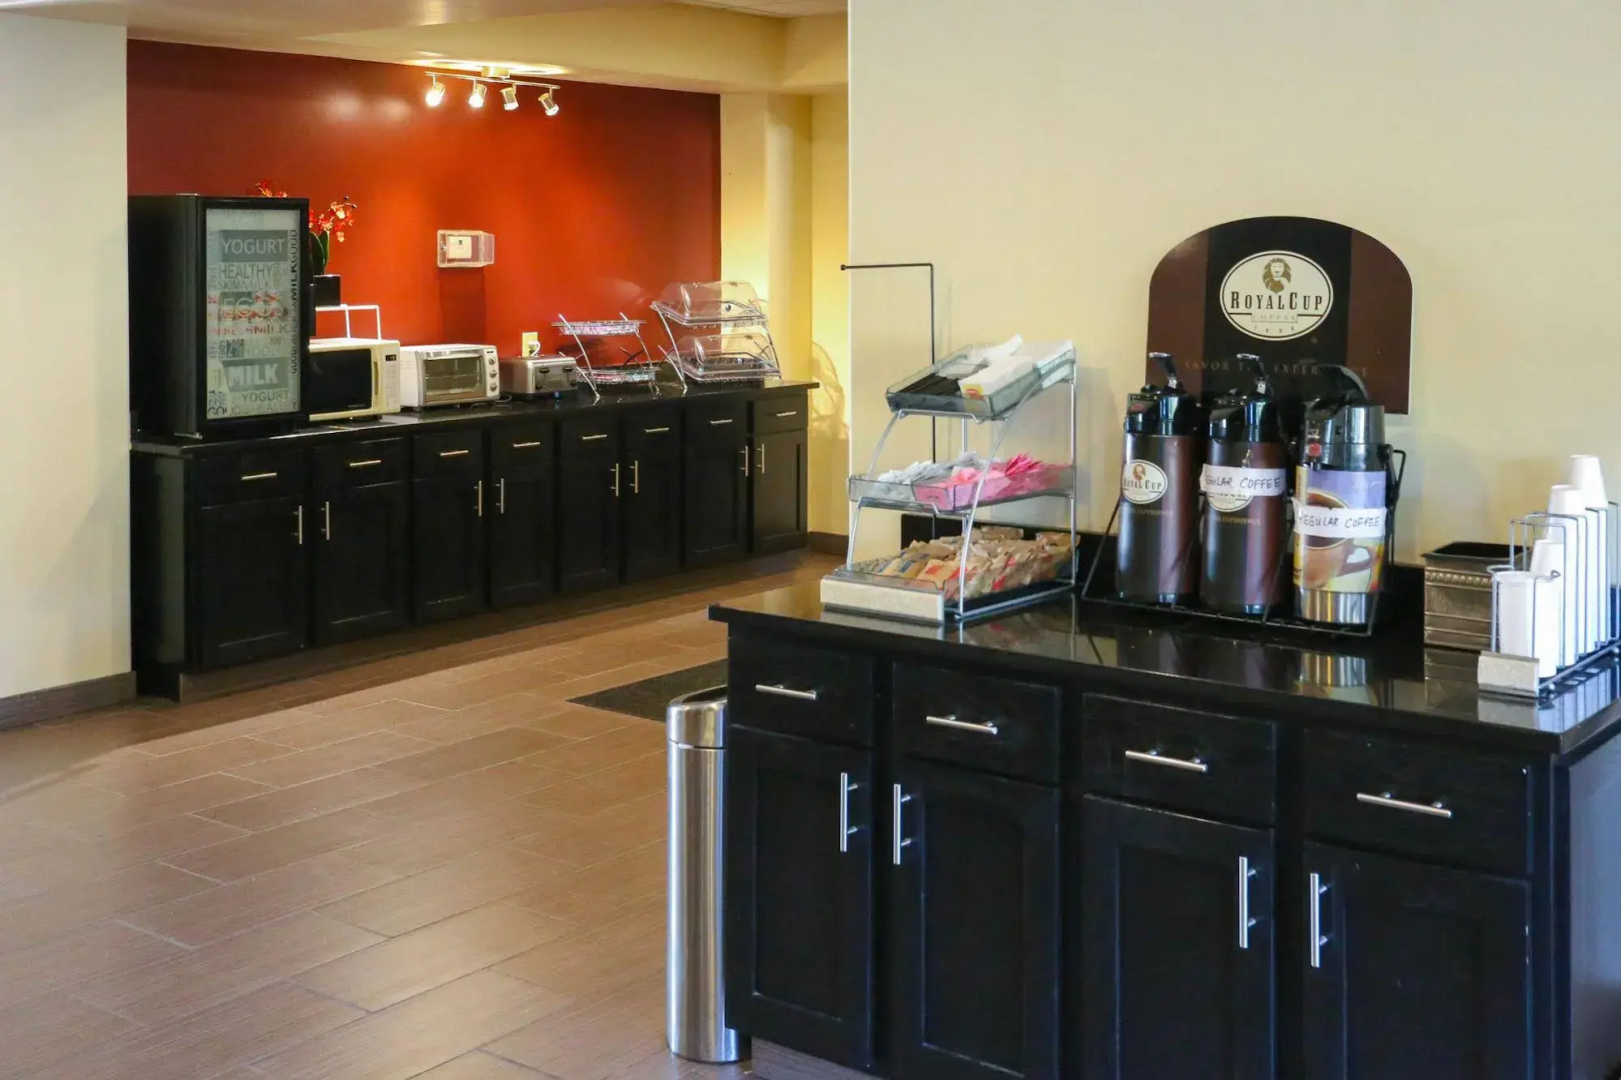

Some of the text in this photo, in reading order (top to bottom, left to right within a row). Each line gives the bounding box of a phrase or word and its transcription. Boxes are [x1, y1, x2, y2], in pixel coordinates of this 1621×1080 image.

[220, 238, 285, 255] YOGURT
[218, 263, 273, 279] HEALTHY
[228, 363, 279, 387] MILK
[242, 389, 289, 403] YOGURT
[1239, 477, 1281, 490] COFFEE
[1344, 517, 1381, 529] COFFEE
